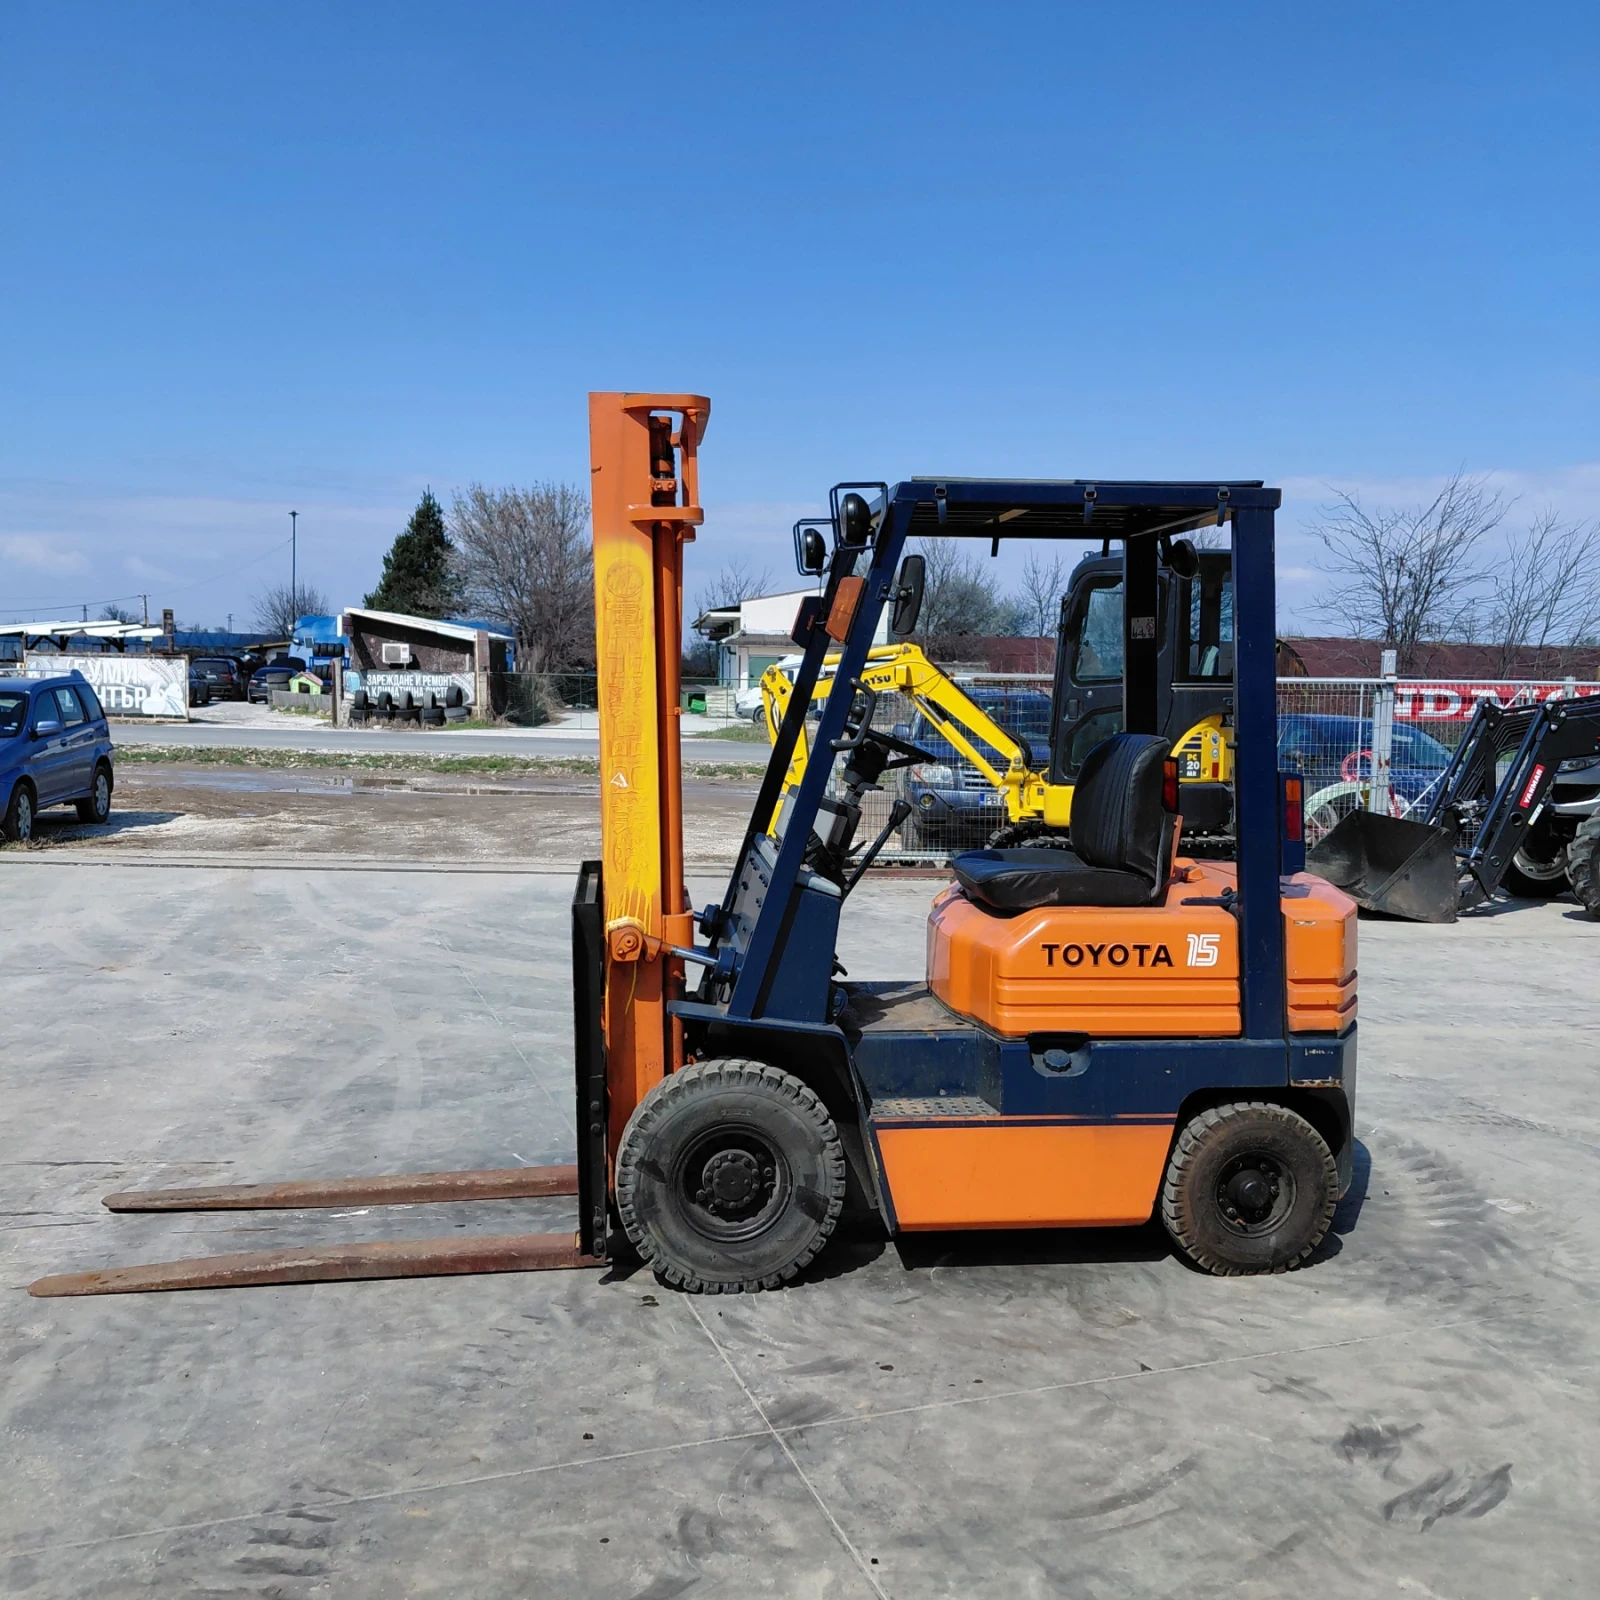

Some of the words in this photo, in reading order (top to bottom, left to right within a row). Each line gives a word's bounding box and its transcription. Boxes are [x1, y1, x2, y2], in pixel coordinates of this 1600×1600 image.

[366, 674, 414, 687] ЗАРЕЖДАНЕ
[422, 674, 453, 687] РЕМОНТ
[863, 674, 892, 686] ATSU
[1187, 753, 1198, 761] PC
[1186, 761, 1200, 770] 20
[1523, 768, 1544, 804] YANMAR
[1041, 943, 1175, 967] TOYOTA
[1186, 933, 1221, 967] 15
